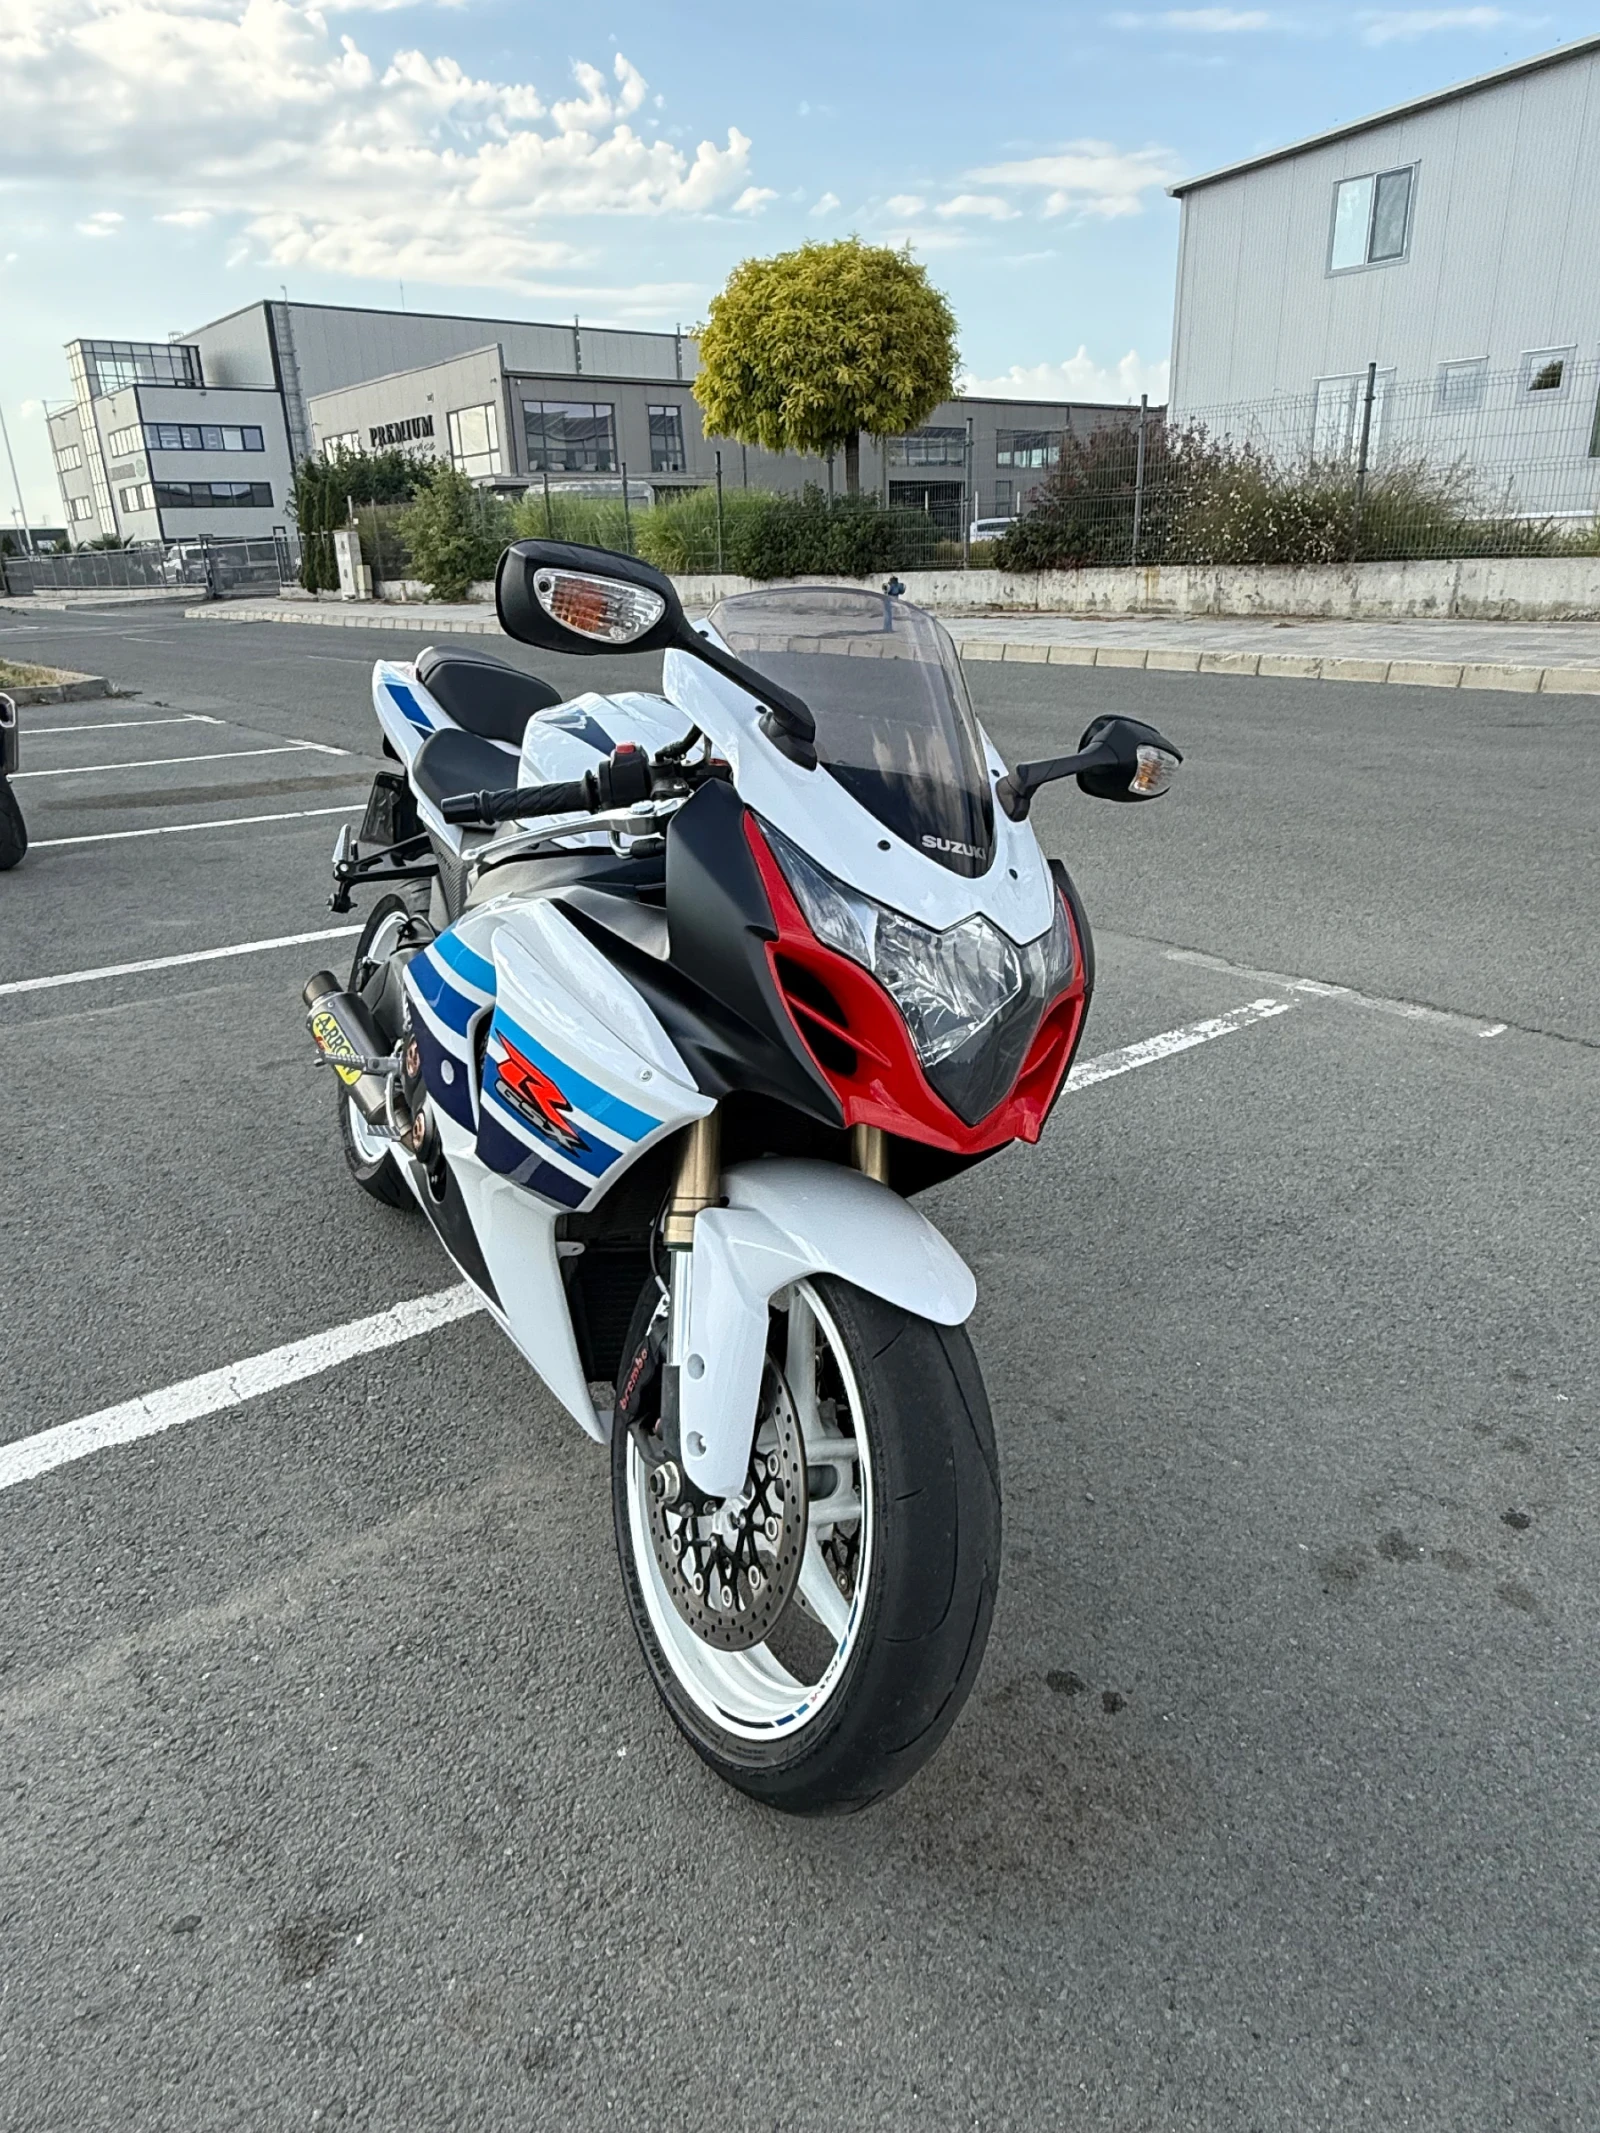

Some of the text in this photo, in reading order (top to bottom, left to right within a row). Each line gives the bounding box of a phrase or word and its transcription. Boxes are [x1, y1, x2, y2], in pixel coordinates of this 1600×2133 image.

[369, 414, 435, 447] PREMIUM
[921, 834, 987, 860] SUZUKI
[619, 1347, 648, 1411] brembo
